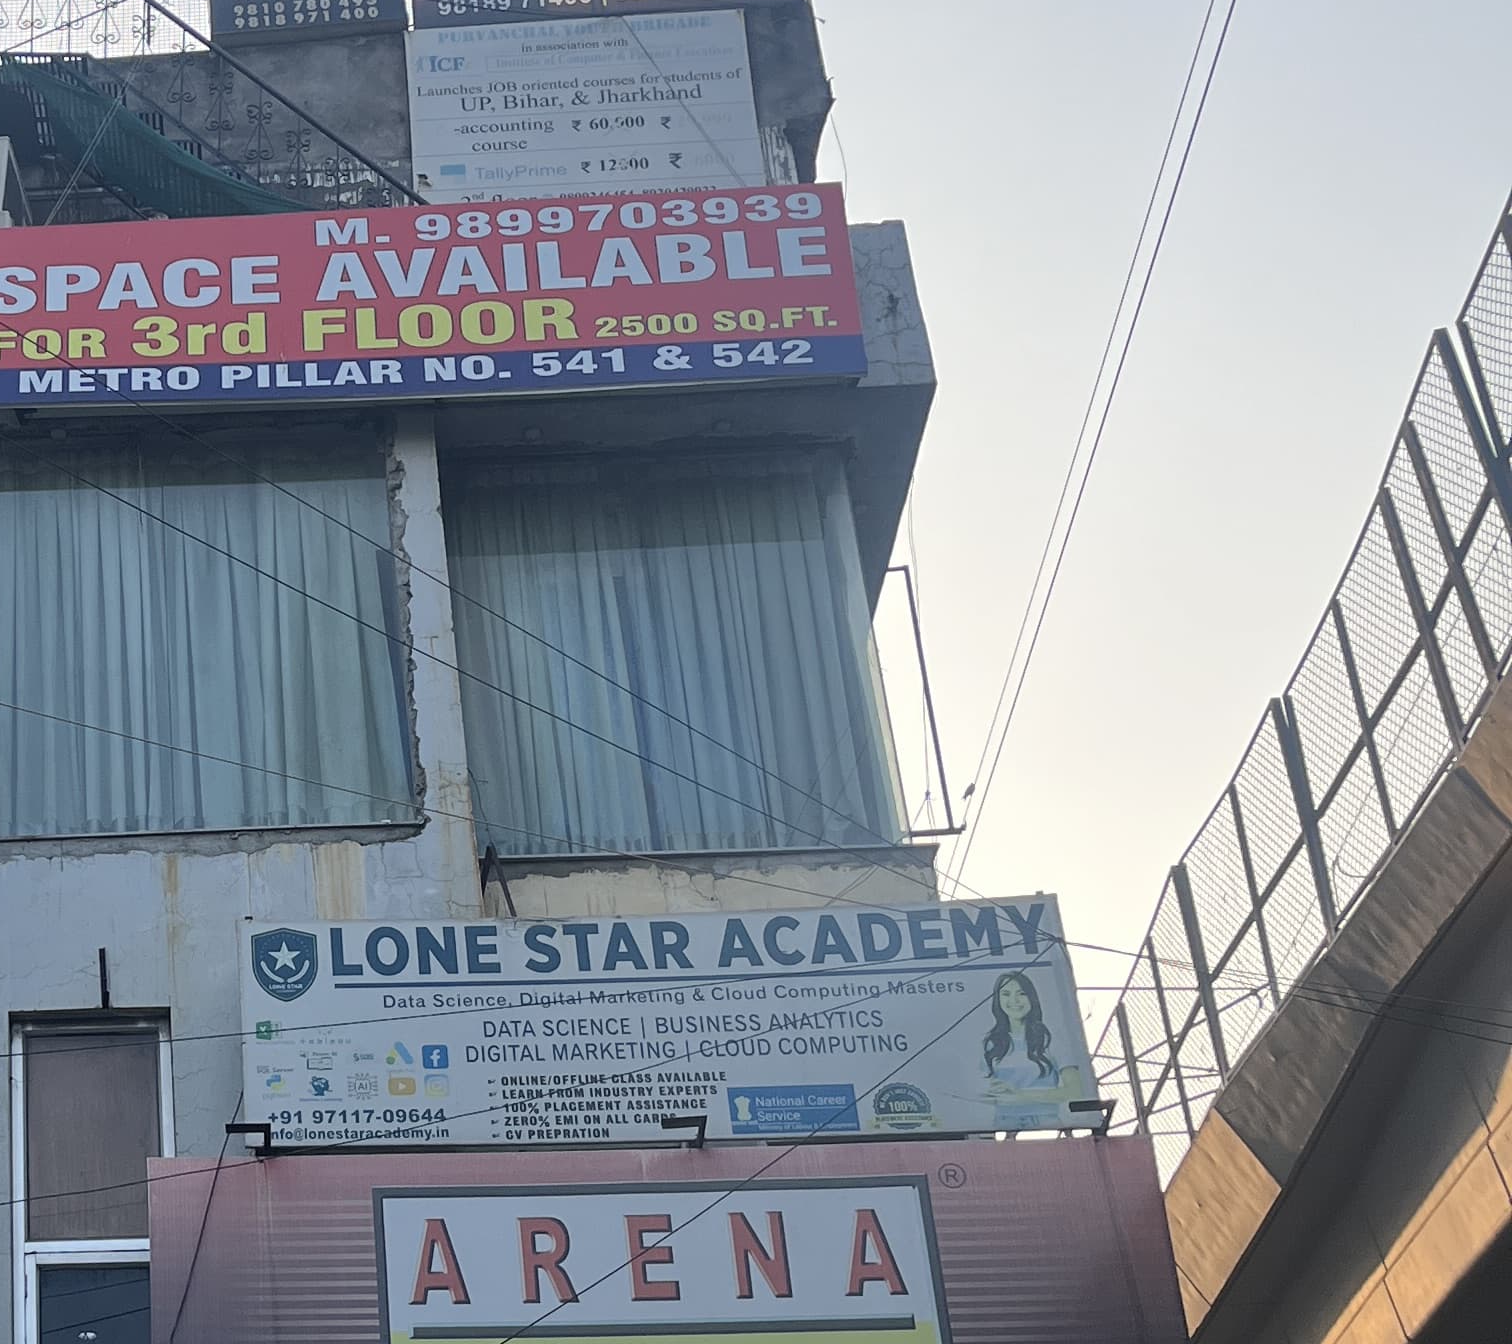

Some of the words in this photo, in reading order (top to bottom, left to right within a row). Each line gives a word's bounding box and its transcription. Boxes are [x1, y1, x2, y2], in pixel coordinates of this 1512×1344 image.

[233, 0, 285, 16] 9810
[293, 0, 331, 12] 780
[235, 14, 286, 28] 9818
[294, 10, 331, 23] 971
[341, 6, 379, 19] 400
[461, 98, 495, 112] UP,
[503, 92, 564, 110] Bihar,
[571, 91, 590, 105] &
[597, 84, 702, 104] Jharkhand
[315, 217, 391, 246] M.
[413, 193, 823, 241] 9899703939
[318, 227, 833, 302] AVAILABLE
[131, 314, 266, 359] 3rd
[301, 298, 579, 352] FLOOR
[594, 314, 697, 338] 2500
[711, 306, 838, 334] SQ.FT.
[18, 367, 200, 394] METRO
[218, 358, 403, 389] PILLAR
[424, 355, 511, 381] NO.
[532, 348, 626, 377] 541
[652, 344, 692, 371] &
[711, 340, 813, 368] 542
[330, 925, 499, 976] LONE
[523, 921, 691, 972] STAR
[717, 904, 1047, 969] ACADEMY
[481, 1013, 536, 1038] DATA
[542, 1010, 632, 1036] SCIENCE
[654, 1009, 764, 1035] BUSINESS
[768, 1007, 885, 1034] ANALYTICS
[464, 1039, 544, 1064] DIGITAL
[551, 1036, 677, 1060] MARKETING
[699, 1034, 774, 1059] CLOUD
[778, 1031, 909, 1056] COMPUTING
[268, 1110, 302, 1124] +91
[312, 1108, 446, 1124] 97117-09644
[408, 1207, 908, 1307] ARENA
